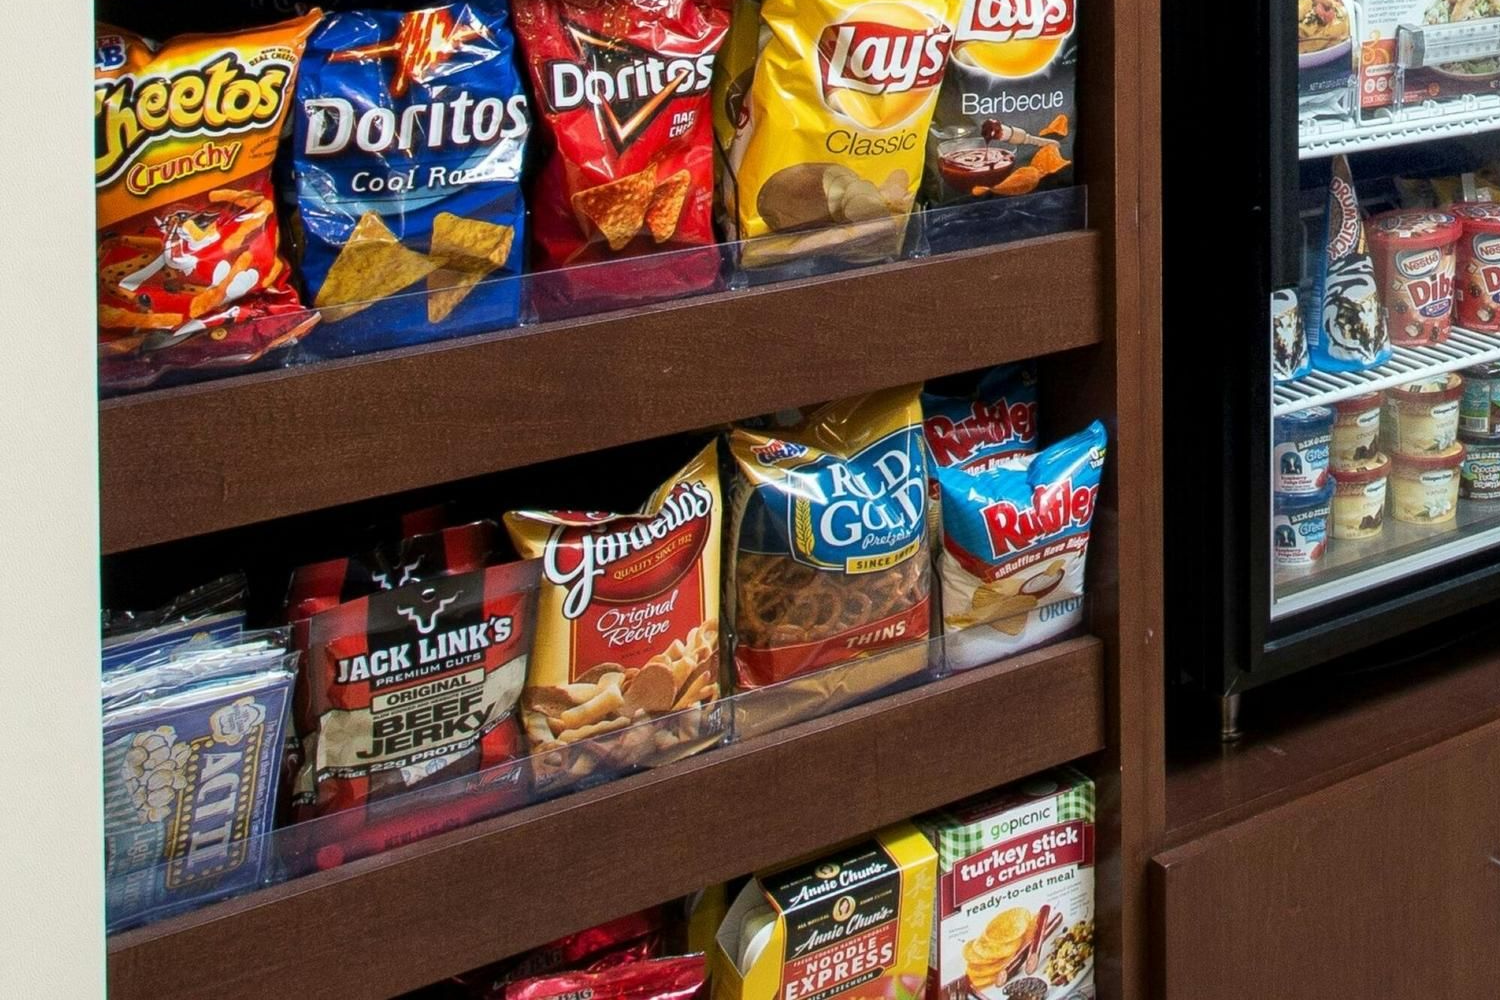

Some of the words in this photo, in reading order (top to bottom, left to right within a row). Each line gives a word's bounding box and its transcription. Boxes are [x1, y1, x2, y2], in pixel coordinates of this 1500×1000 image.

[552, 54, 716, 109] Doritos
[827, 25, 952, 95] Lay's
[95, 57, 286, 176] heetos
[304, 86, 529, 158] Doritos
[962, 89, 1065, 115] Barbecue
[826, 129, 917, 157] Classic
[128, 141, 241, 195] Crunchy
[351, 164, 414, 194] Cool
[1327, 176, 1360, 261] DRUMSTICK
[982, 478, 1099, 559] Ruffles
[613, 558, 653, 581] QUALITY
[655, 542, 676, 563] SINCE
[856, 557, 891, 570] SINCE
[596, 589, 679, 633] Original
[602, 619, 671, 648] Recipe
[846, 620, 907, 648] THINS
[1039, 597, 1084, 623] ORIGI
[338, 643, 410, 683] JACK
[418, 617, 512, 665] LINK'S
[376, 663, 440, 688] PREMIUM
[445, 652, 481, 669] CUTS
[386, 675, 471, 706] ORIGINAL
[356, 702, 496, 759] JERKY
[373, 691, 484, 739] BEEF
[370, 758, 407, 772] 22g
[411, 733, 481, 763] PROTEIN
[960, 843, 1029, 882] turkey
[1032, 826, 1079, 854] stick
[985, 876, 995, 888] &
[998, 852, 1057, 884] crunch
[790, 880, 838, 911] Annie
[839, 862, 888, 886] Chun's
[966, 882, 1043, 918] ready-to-eat
[1046, 869, 1075, 887] meal
[791, 925, 844, 959] Annie
[846, 906, 893, 935] Chun's
[805, 936, 877, 976] NOODLE
[785, 941, 893, 1000] EXPRESS
